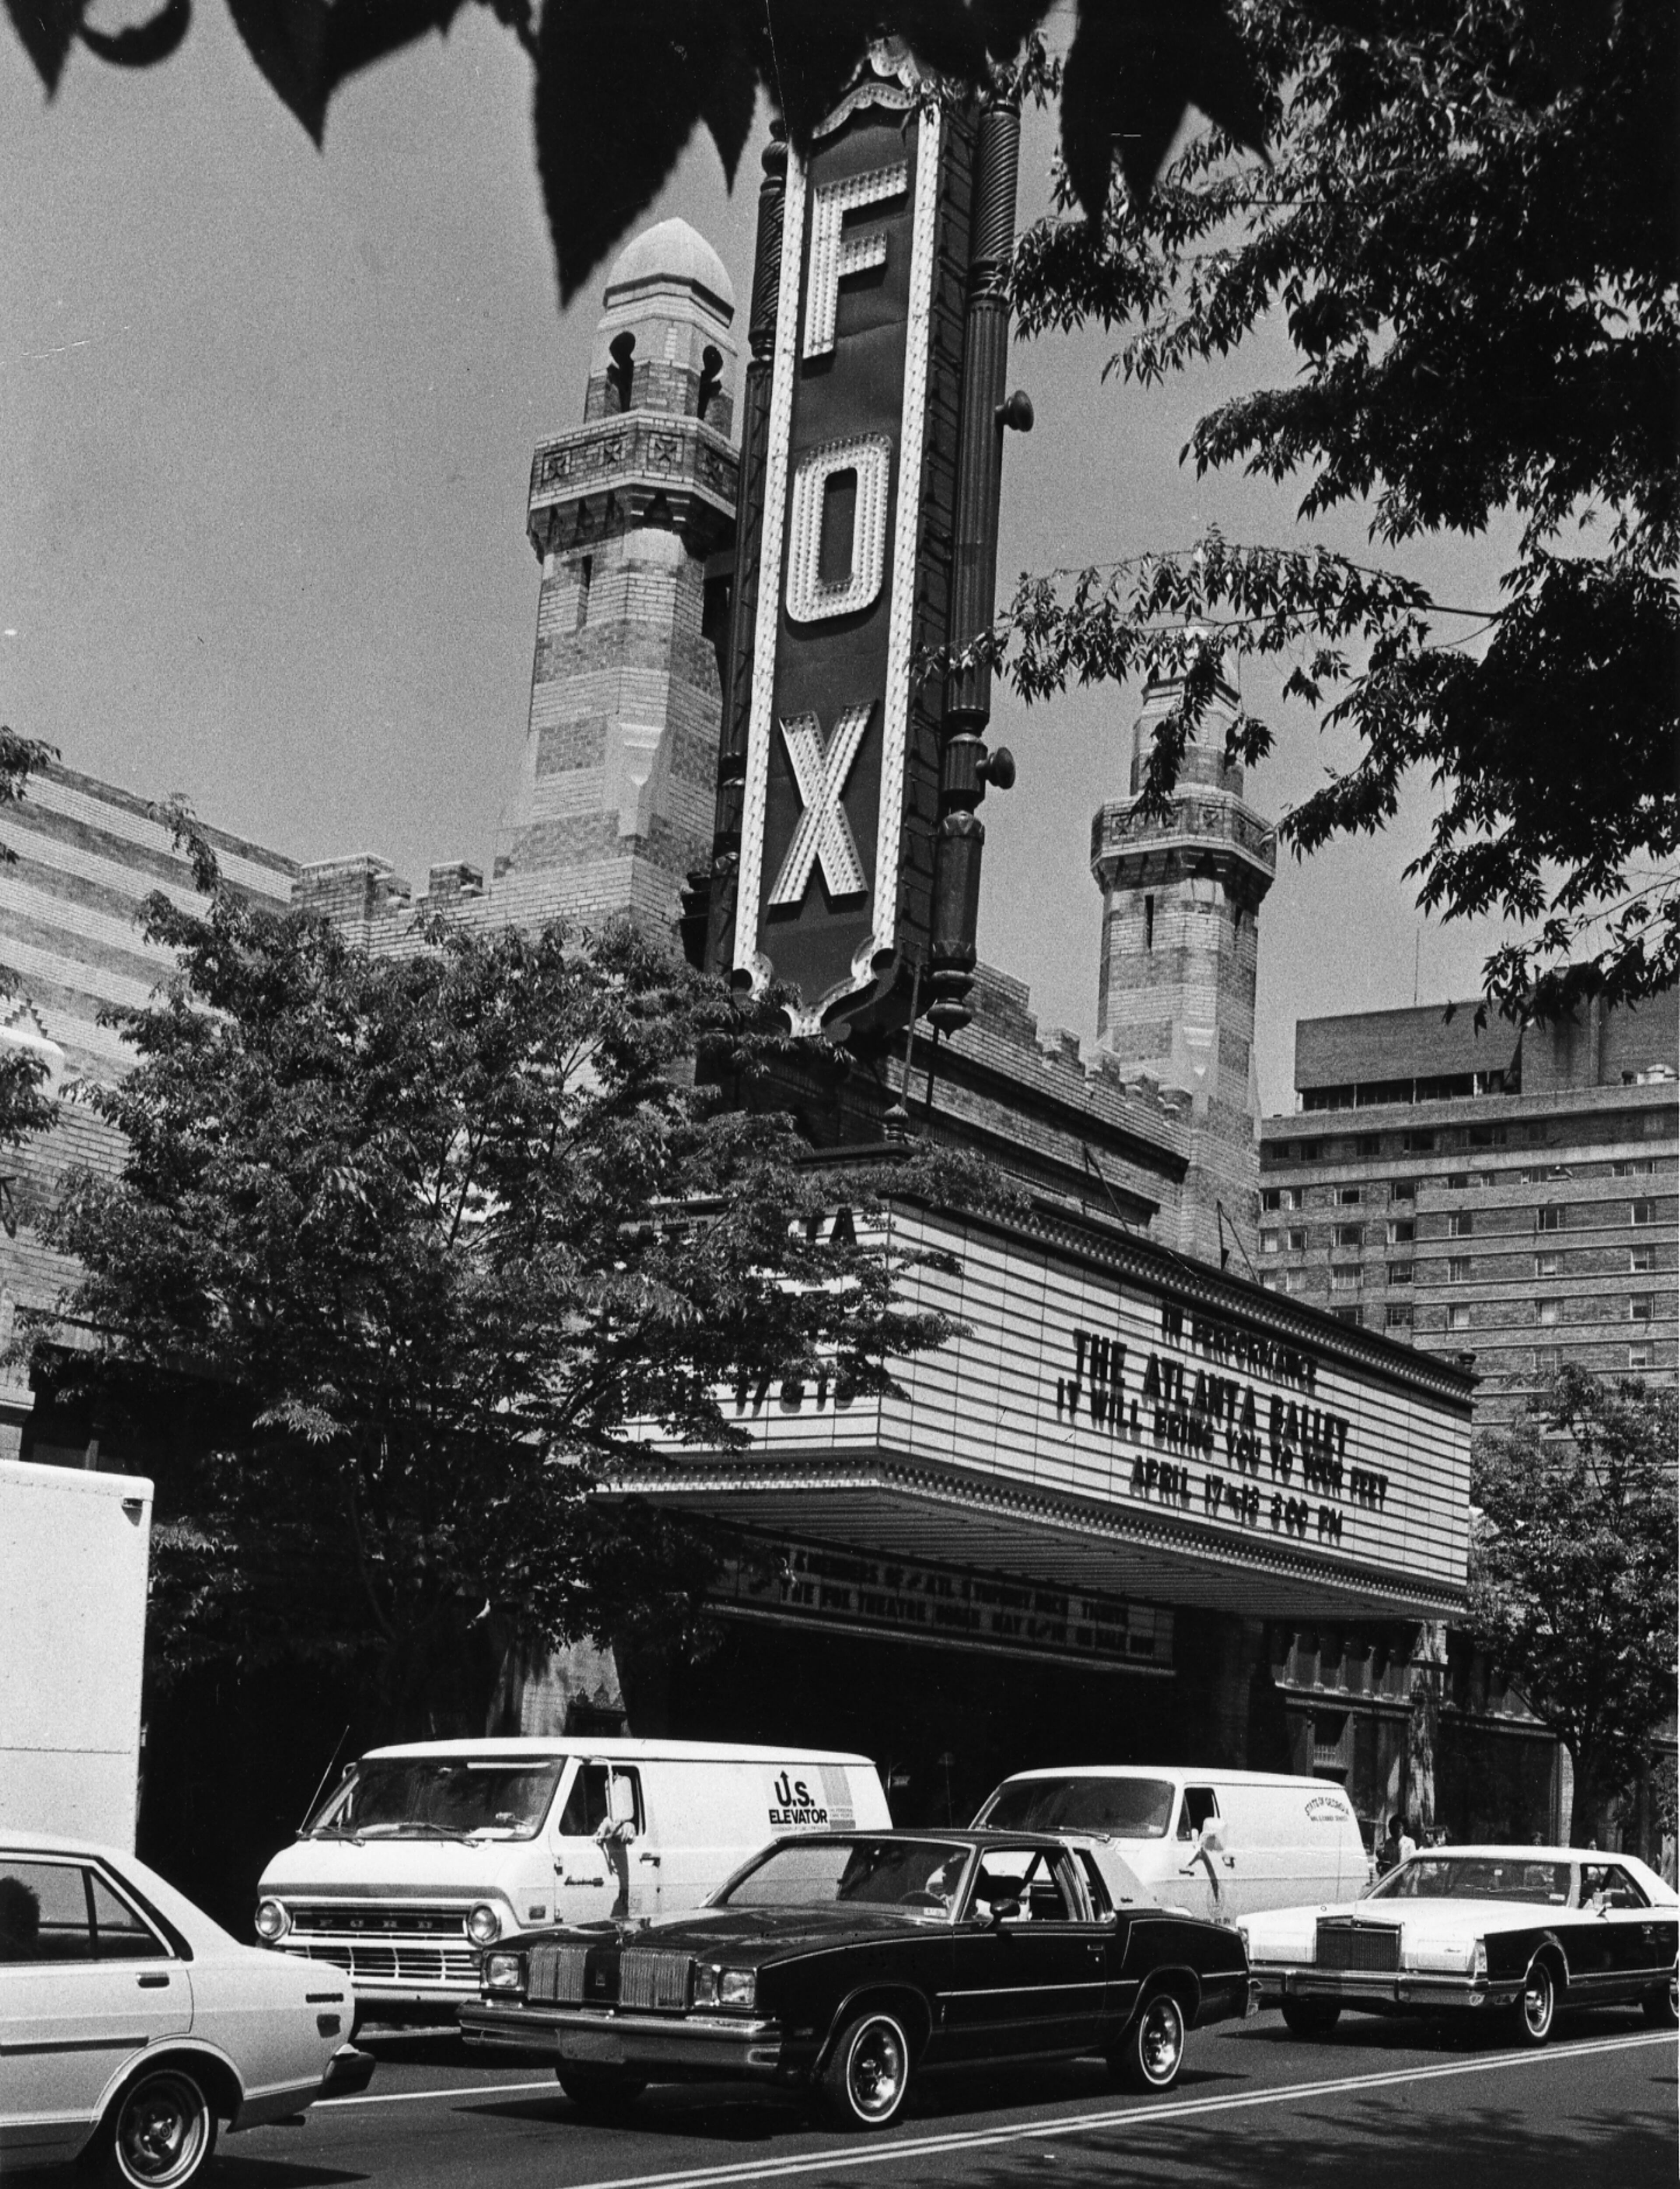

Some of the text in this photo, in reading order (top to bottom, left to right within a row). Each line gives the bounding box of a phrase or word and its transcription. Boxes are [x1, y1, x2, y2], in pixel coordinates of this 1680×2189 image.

[768, 158, 908, 905] FOX
[1073, 1328, 1350, 1455] THE ATLANTA BALLET
[1057, 1377, 1082, 1414] IT
[1091, 1387, 1143, 1432] WILL
[1154, 1405, 1214, 1451] BRING
[1225, 1427, 1261, 1463] YOU
[1270, 1444, 1293, 1471] TO
[1351, 1466, 1388, 1501] FEET
[1133, 1455, 1192, 1498] APRIL
[1318, 1505, 1343, 1537] PM
[769, 1809, 828, 1824] ELEVATOR
[774, 1771, 815, 1807] U.S.
[319, 1919, 433, 1929] FORD
